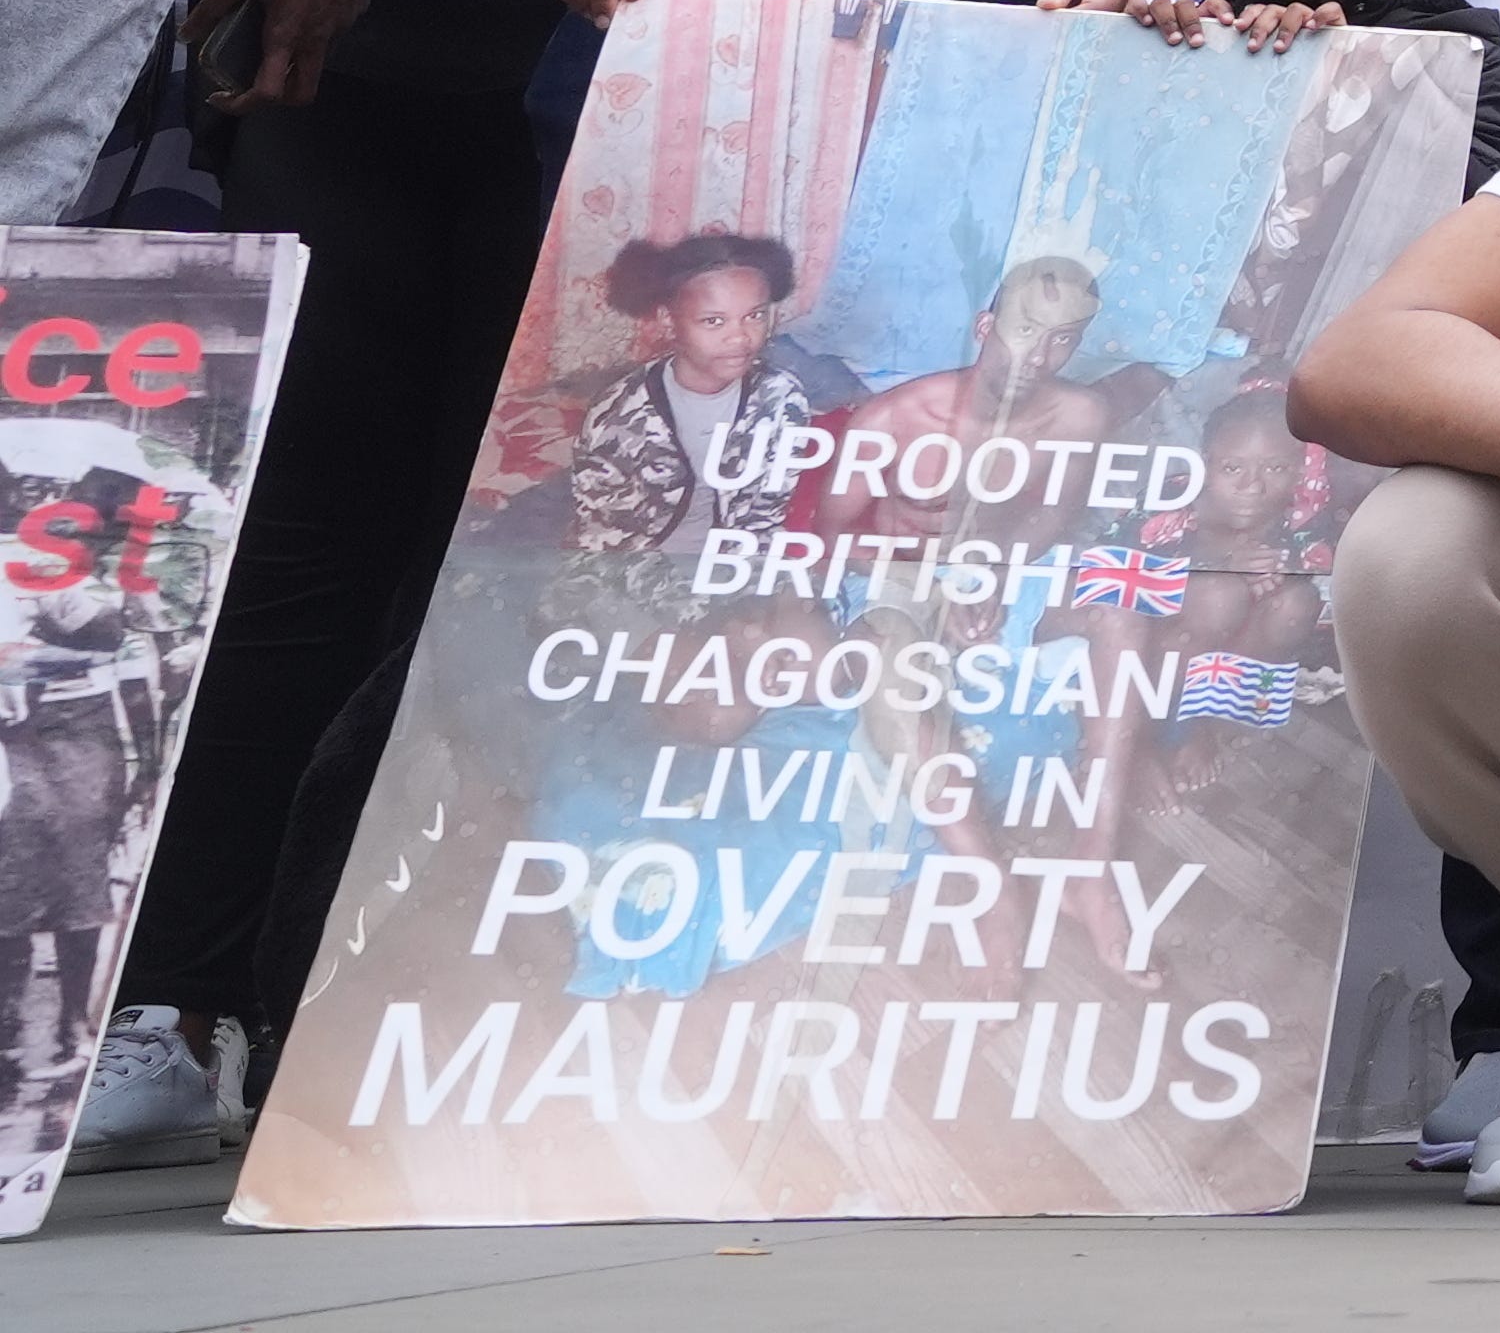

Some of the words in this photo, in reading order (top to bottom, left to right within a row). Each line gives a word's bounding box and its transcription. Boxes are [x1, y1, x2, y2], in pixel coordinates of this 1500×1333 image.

[700, 420, 1207, 513] UPROOTED
[690, 527, 1073, 610] BRITISH
[525, 627, 1182, 722] CHAGOSSIAN
[640, 745, 978, 828] LIVING
[1001, 754, 1108, 830] IN
[470, 838, 1207, 973] POVERTY
[347, 999, 1274, 1129] MAURITIUS
